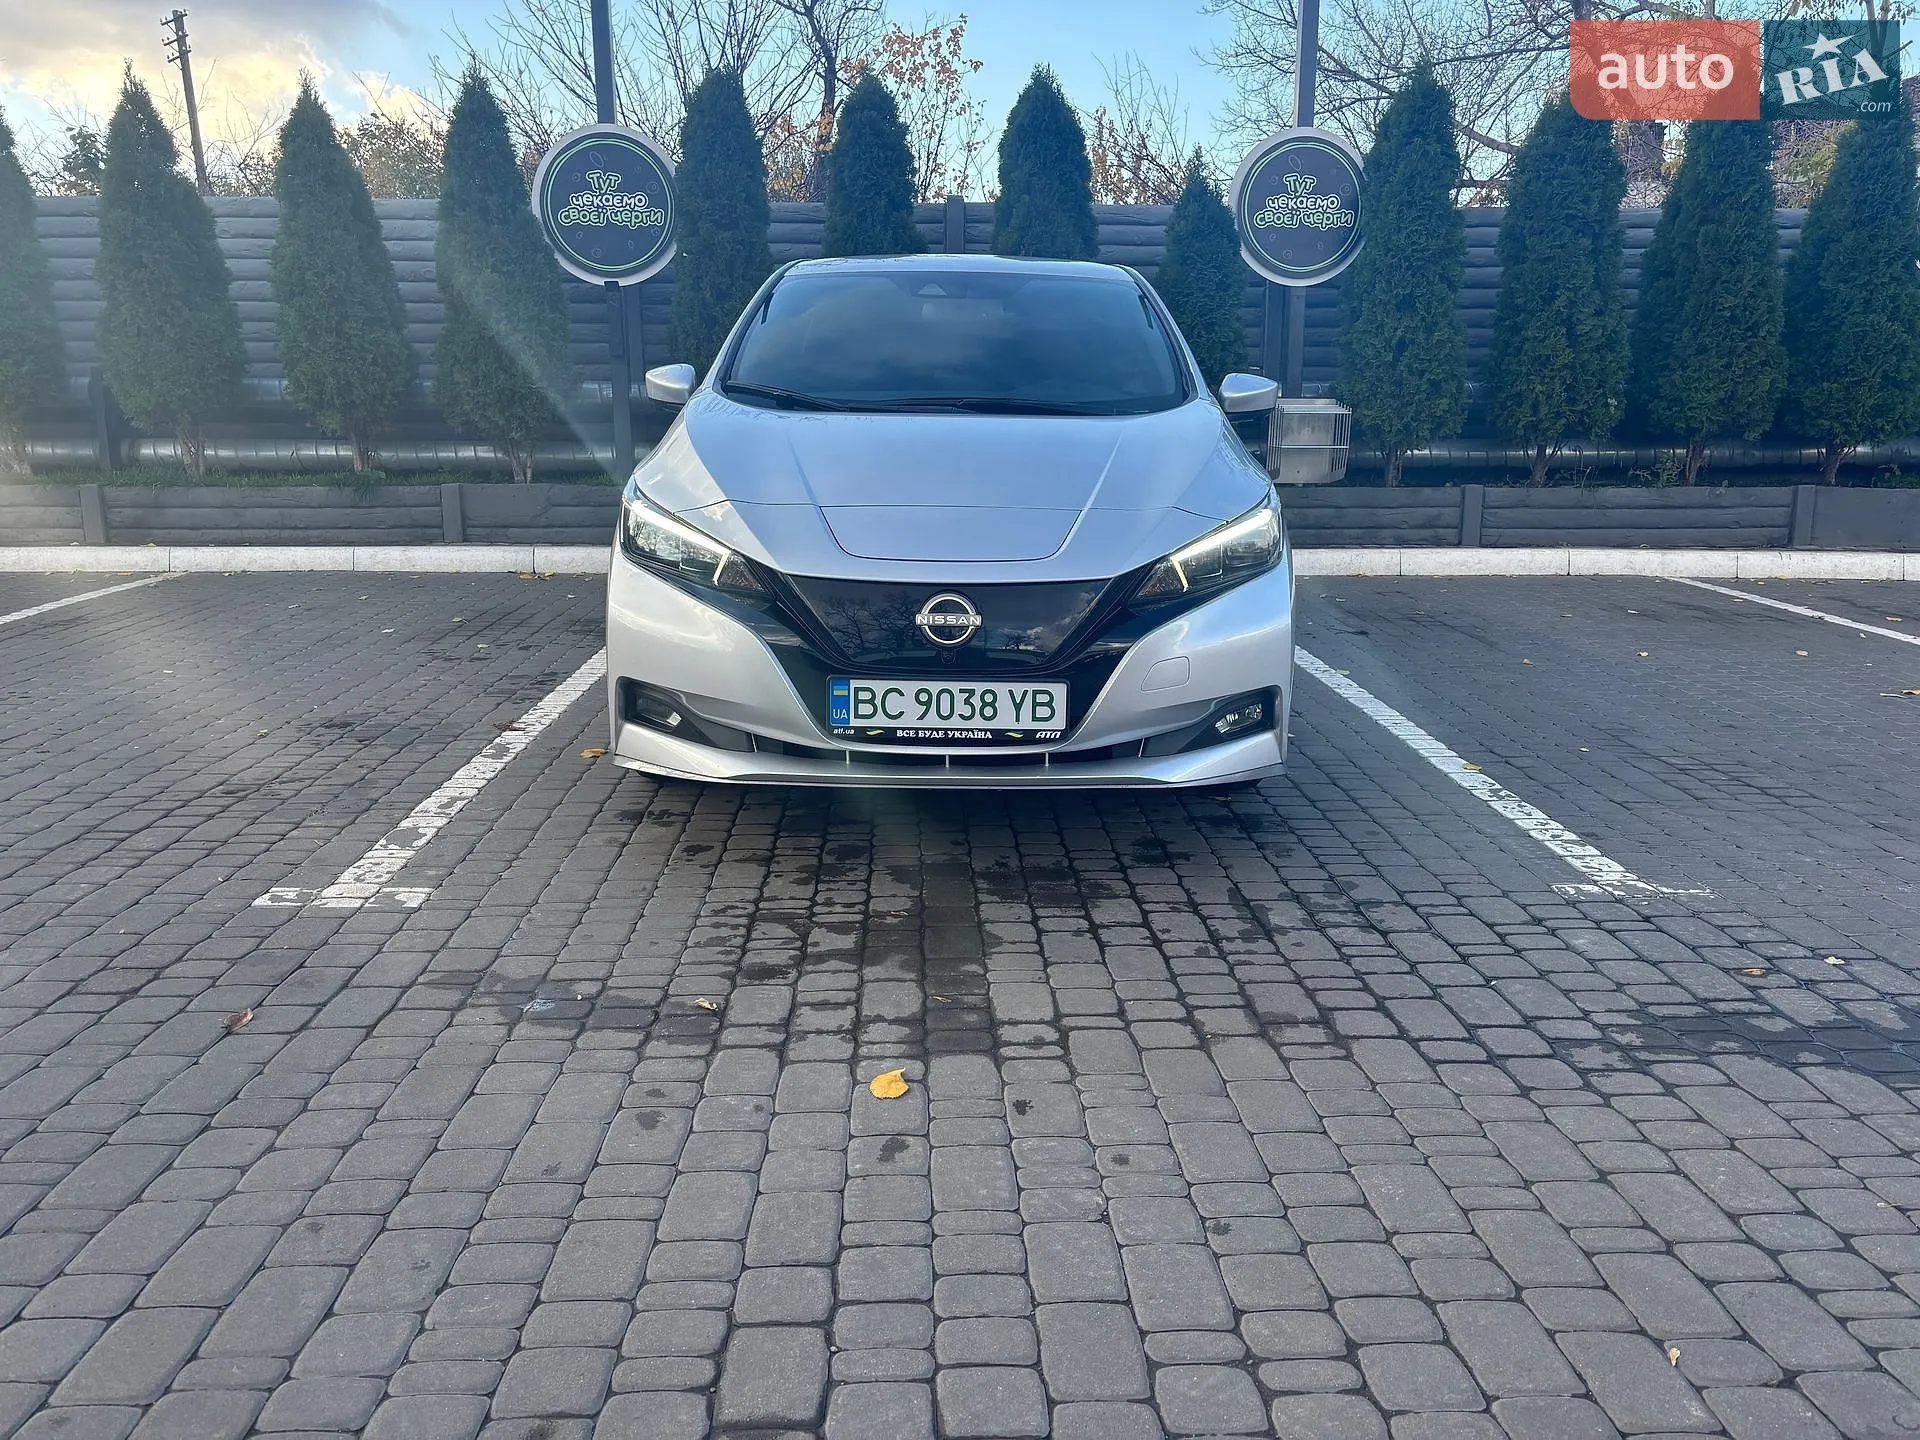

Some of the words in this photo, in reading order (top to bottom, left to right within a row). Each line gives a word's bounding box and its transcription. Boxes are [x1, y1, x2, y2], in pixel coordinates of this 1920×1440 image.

[587, 171, 620, 194] Тут
[1285, 174, 1316, 195] Тут
[570, 192, 648, 209] чекаємо
[1267, 195, 1340, 211] чекаємо
[559, 207, 607, 225] своєї
[610, 208, 663, 229] черги
[1255, 210, 1301, 227] своєї
[1302, 210, 1353, 230] черги
[917, 615, 980, 625] NISSAN
[853, 686, 905, 720] BC
[914, 687, 998, 721] 9038
[833, 708, 848, 719] UA
[896, 729, 916, 738] ВСЕ
[918, 729, 945, 739] БУДЕ
[947, 729, 993, 739] УКРАЇНА
